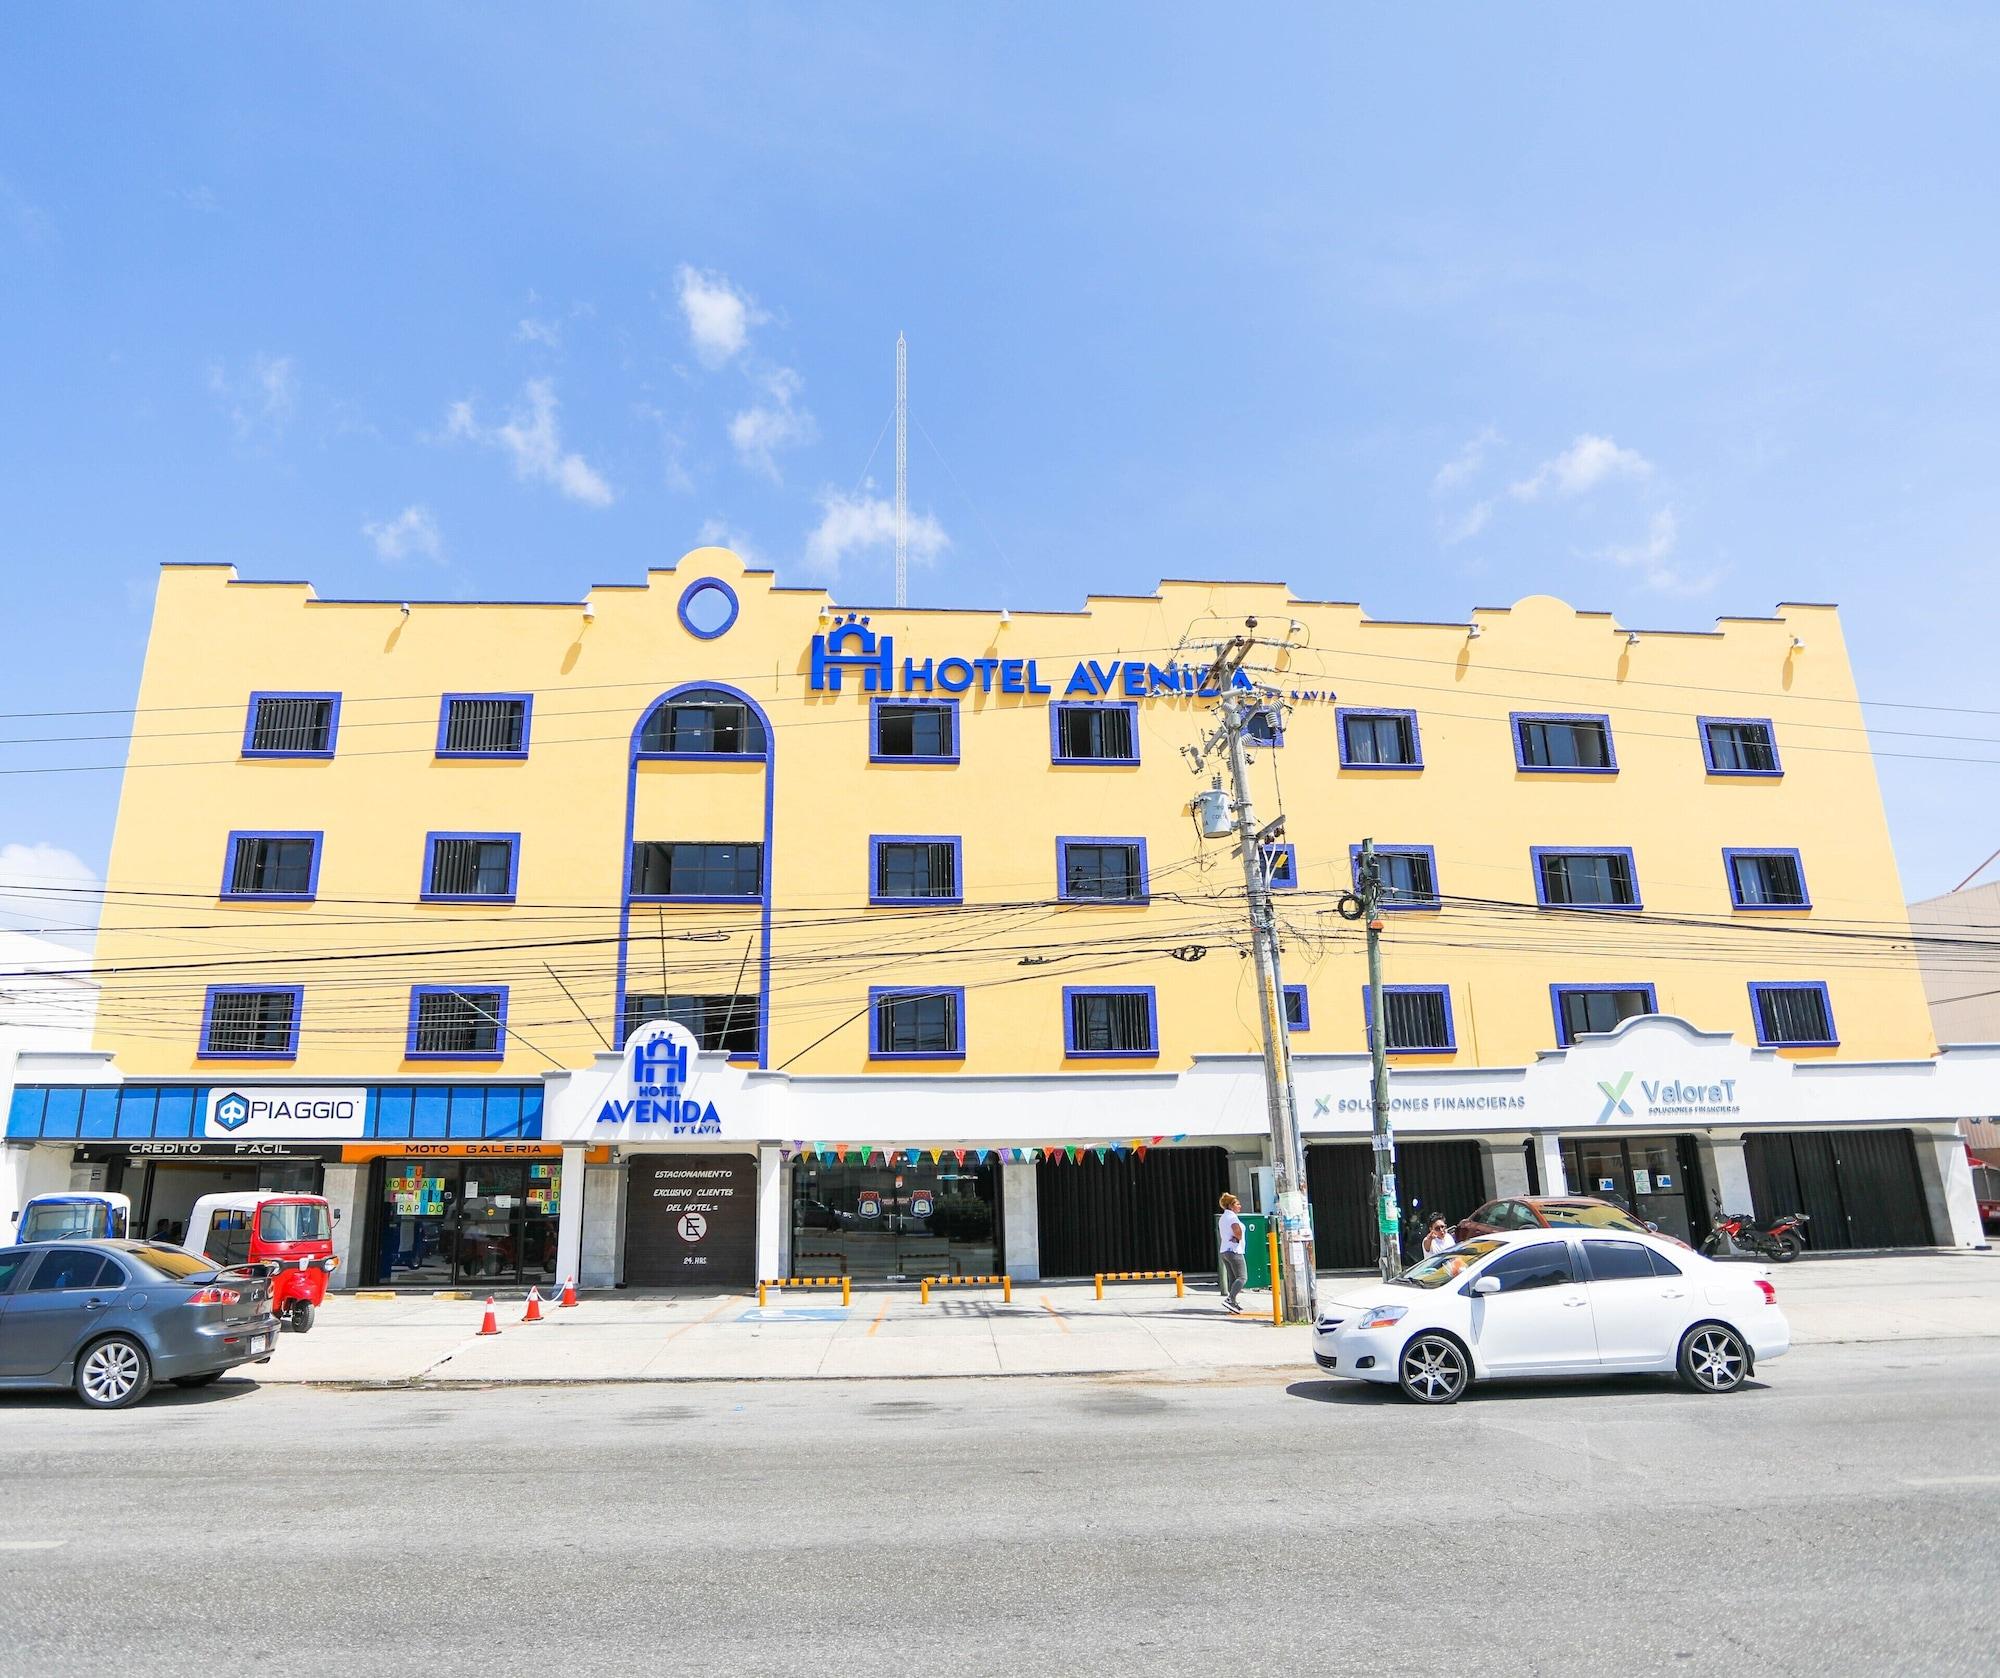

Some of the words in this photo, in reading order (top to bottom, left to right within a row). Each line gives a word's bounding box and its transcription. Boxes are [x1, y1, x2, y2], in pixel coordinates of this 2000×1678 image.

[904, 657, 1051, 694] HOTEL
[1065, 660, 1254, 698] AVENIDA
[1291, 690, 1337, 700] KAVIA
[639, 1086, 681, 1097] HOTEL
[1641, 1079, 1736, 1103] ValoraT
[1338, 1098, 1429, 1112] SOLUONES
[1433, 1096, 1526, 1111] FINANCIERAS
[250, 1101, 354, 1119] PIAGGIO
[596, 1099, 721, 1123] AVENIDA
[1648, 1106, 1693, 1114] SOLUCIONES
[1694, 1105, 1741, 1113] FINANCIERAS
[674, 1126, 685, 1134] BY
[129, 1144, 202, 1154] CREDITO
[234, 1144, 291, 1154] FACIL
[405, 1144, 450, 1154] MOTO
[466, 1144, 542, 1153] GALERIA
[408, 1168, 422, 1177] TU
[654, 1170, 733, 1179] ESTACIONAMIENTO
[385, 1180, 443, 1189] MOTOTAXI
[653, 1188, 692, 1197] EXCLUSIVO
[696, 1188, 734, 1197] CLIENTES
[399, 1204, 443, 1213] RAPIDO
[666, 1203, 682, 1212] DEL
[684, 1203, 712, 1212] HOTEL
